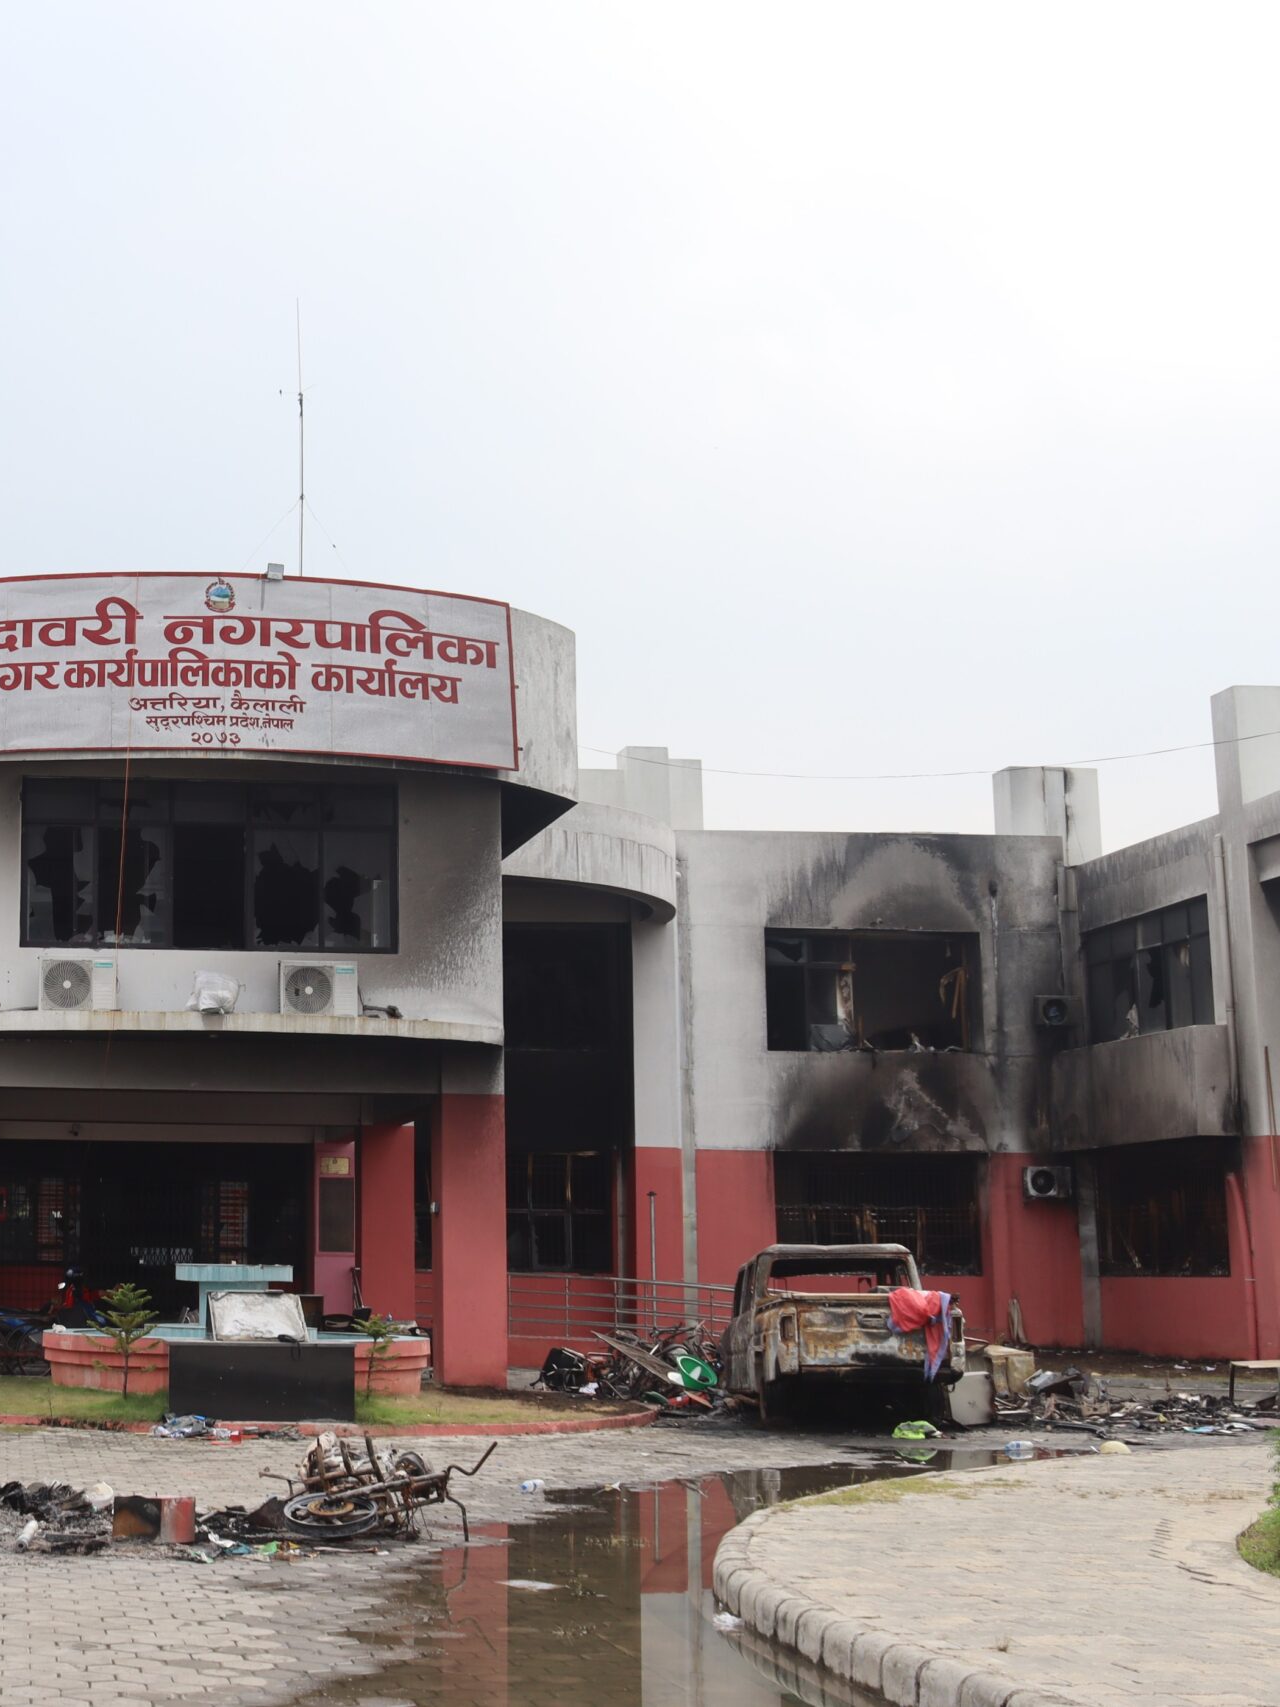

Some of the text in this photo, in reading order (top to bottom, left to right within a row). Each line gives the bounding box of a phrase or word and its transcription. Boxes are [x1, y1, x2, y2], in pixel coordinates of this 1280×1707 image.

[163, 609, 500, 669] नगरपालिका
[64, 646, 301, 690] कार्यपालिकाको
[311, 658, 463, 705] कार्यालय
[230, 689, 307, 715] कैलाली
[191, 732, 241, 747] २०७३
